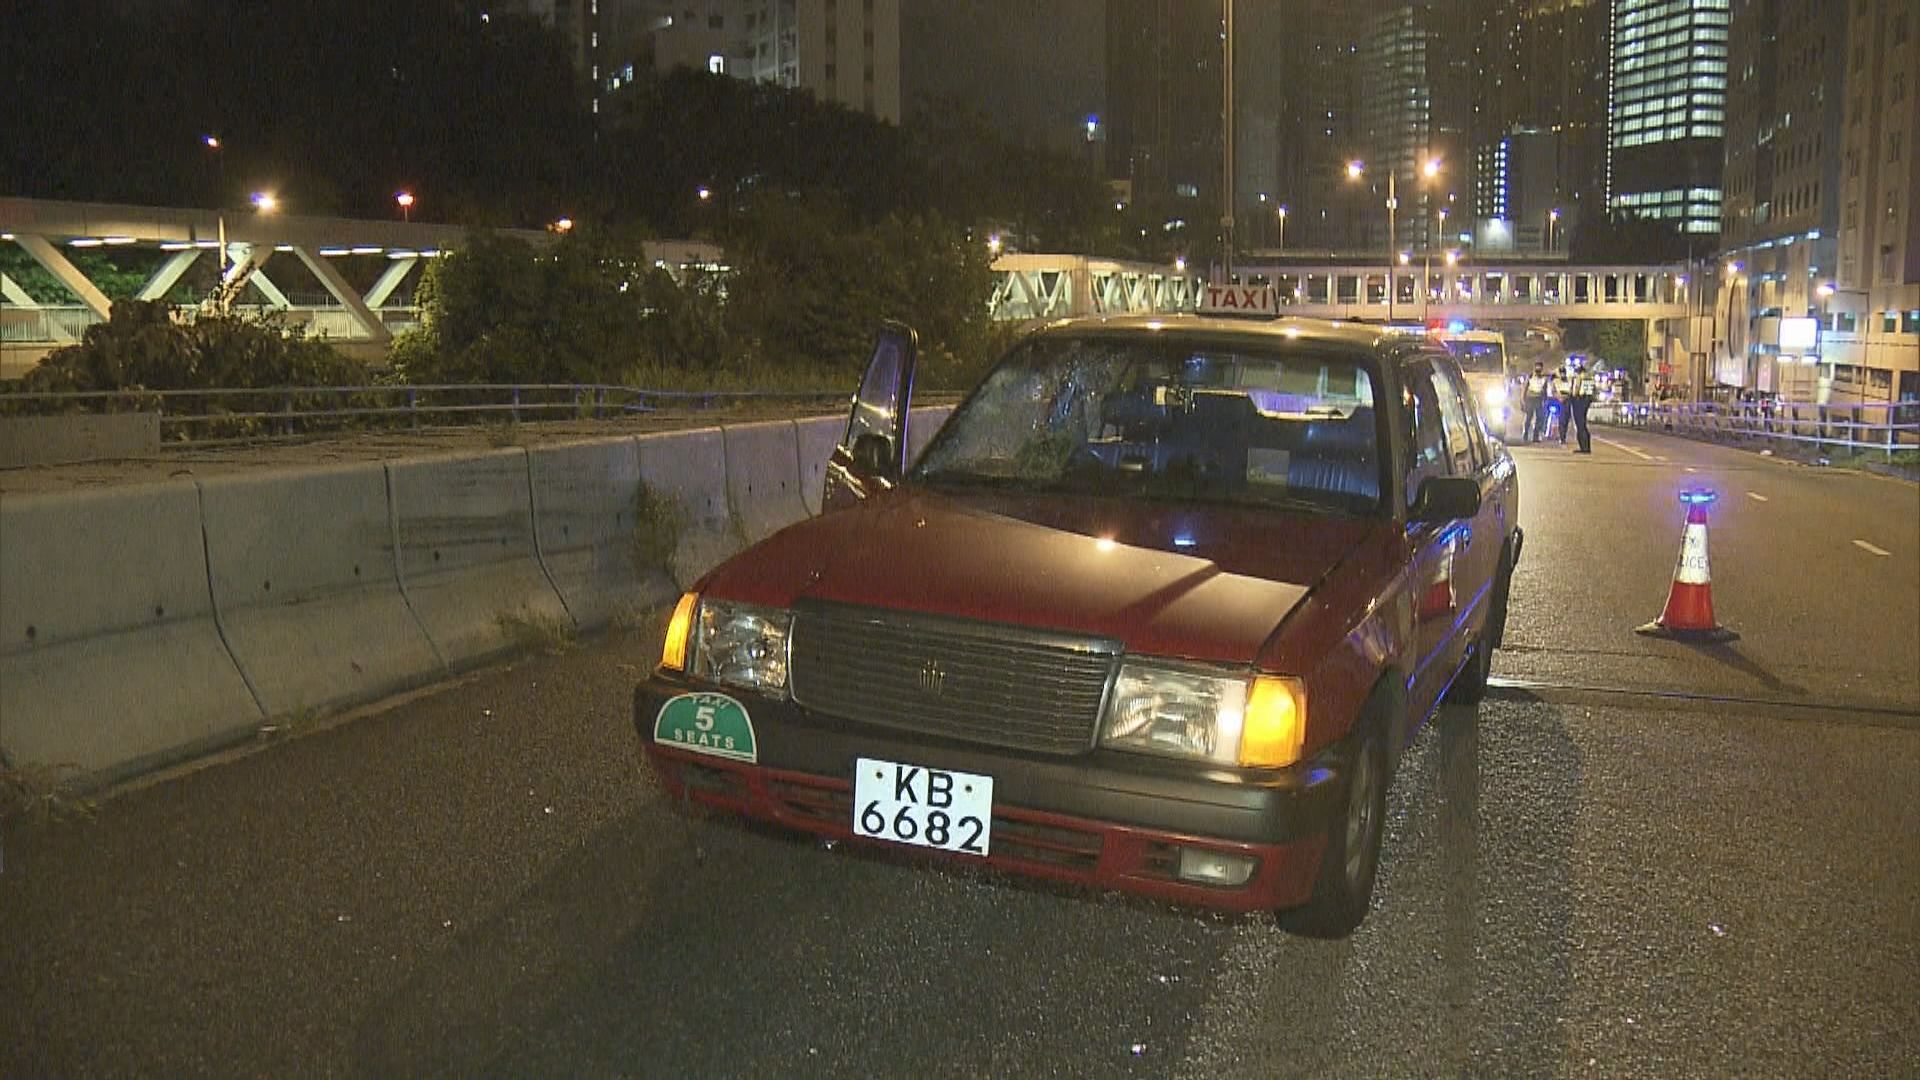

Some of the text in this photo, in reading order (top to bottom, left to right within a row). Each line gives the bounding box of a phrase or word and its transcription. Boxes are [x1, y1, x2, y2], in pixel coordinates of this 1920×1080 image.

[1207, 288, 1267, 309] TAXI
[695, 706, 715, 731] 5
[674, 728, 734, 749] SEATS
[895, 766, 953, 809] KB
[861, 800, 983, 853] 6682
